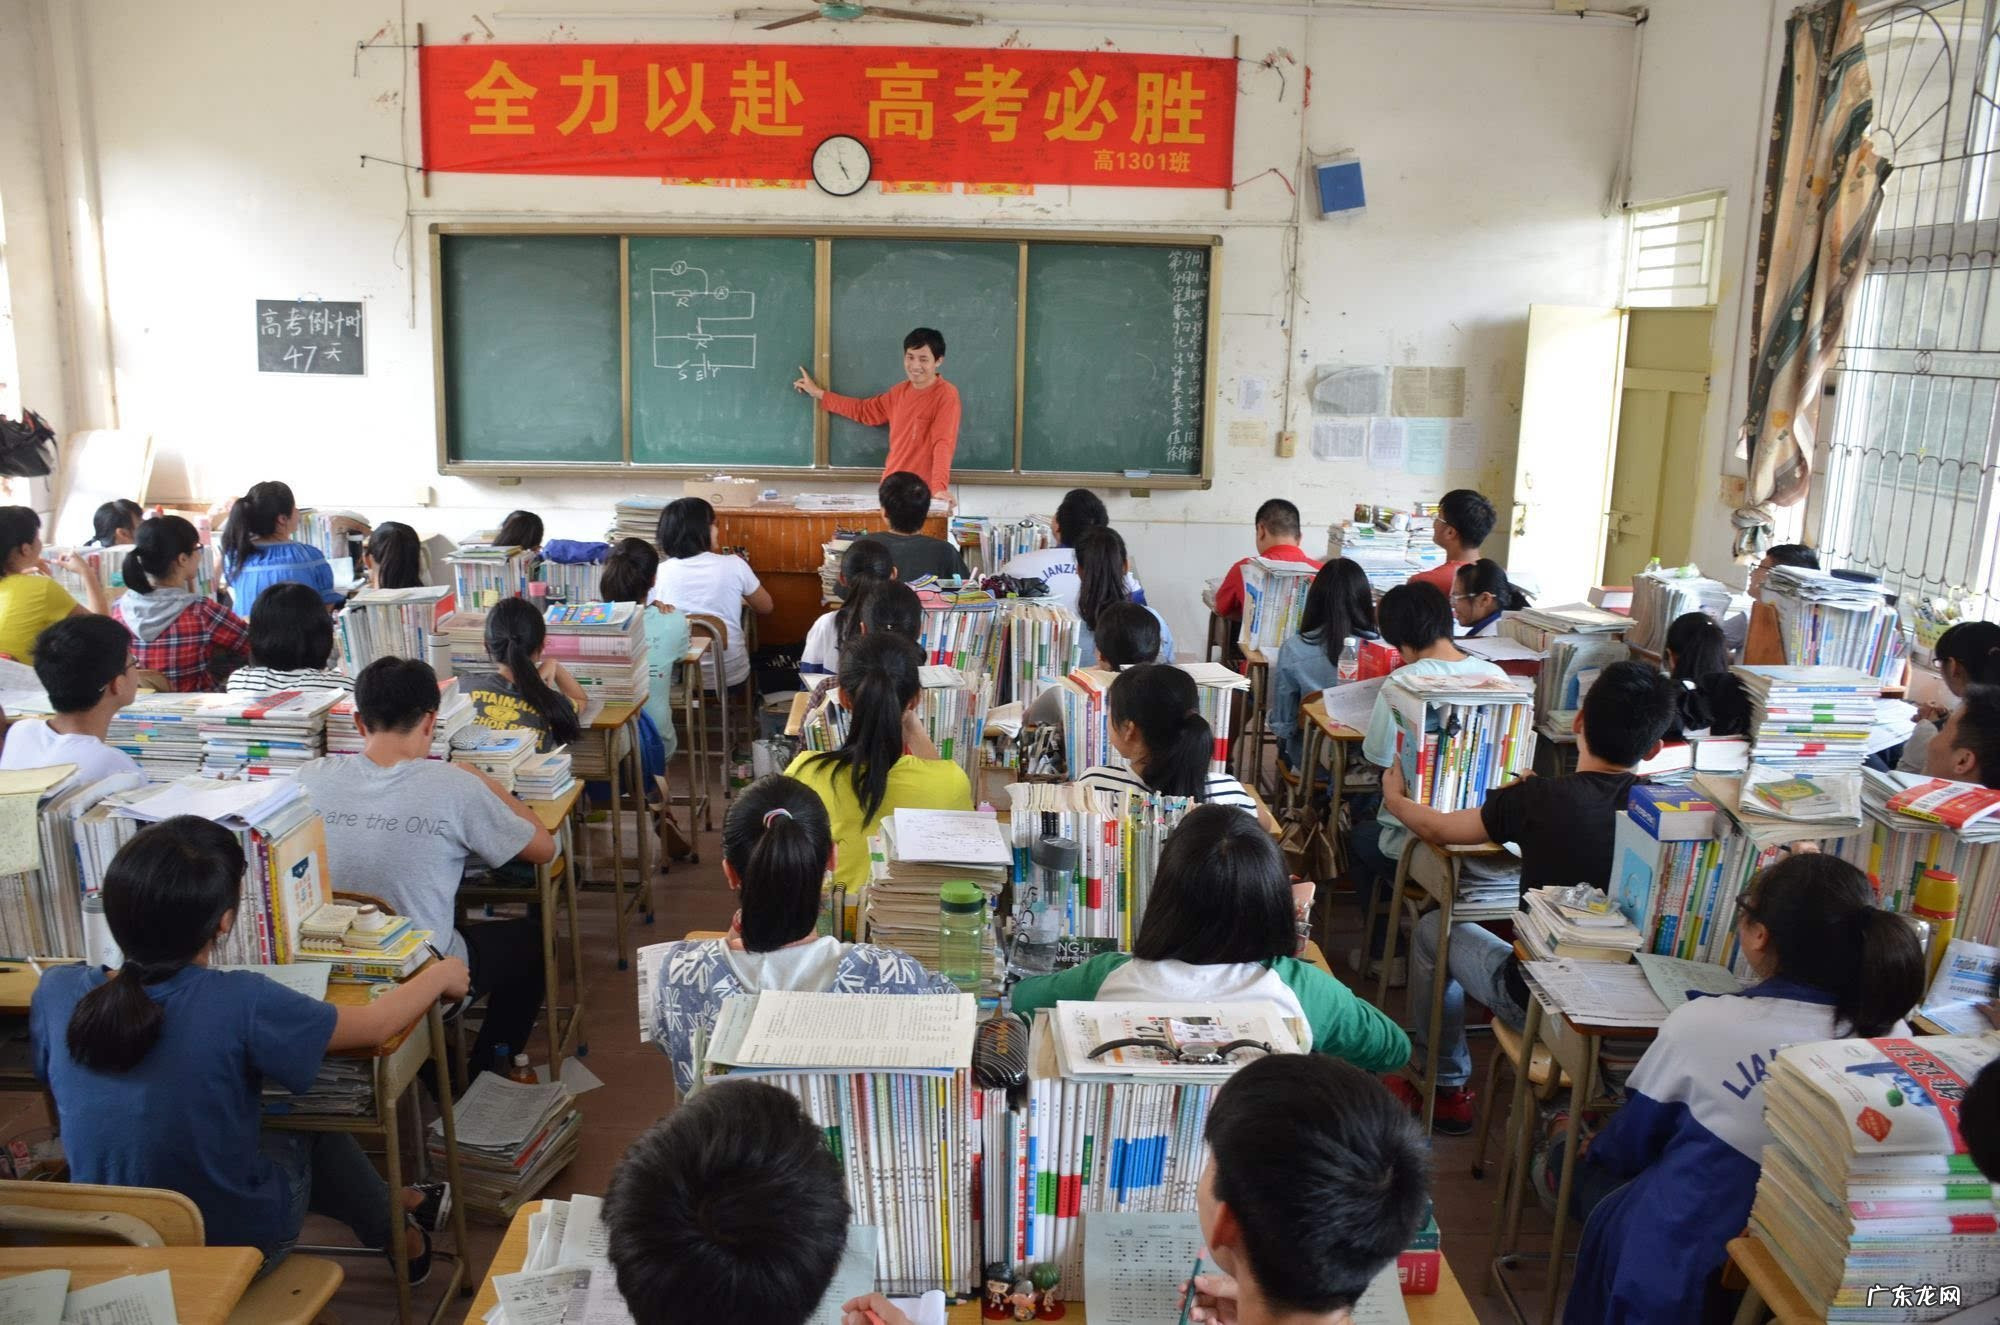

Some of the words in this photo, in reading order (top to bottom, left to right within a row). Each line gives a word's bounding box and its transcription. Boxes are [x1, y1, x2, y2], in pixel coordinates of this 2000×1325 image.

[465, 60, 805, 136] 全力以赴
[867, 63, 1205, 144] 高考必胜
[1094, 149, 1191, 173] 高1301班
[261, 307, 362, 338] 高考倒计时
[283, 342, 343, 373] 47天
[471, 690, 516, 707] PTAIN
[326, 810, 358, 827] are
[365, 812, 399, 831] the
[405, 816, 449, 836] ONE
[1058, 941, 1090, 953] NGJI
[1722, 1048, 1779, 1100] LIA
